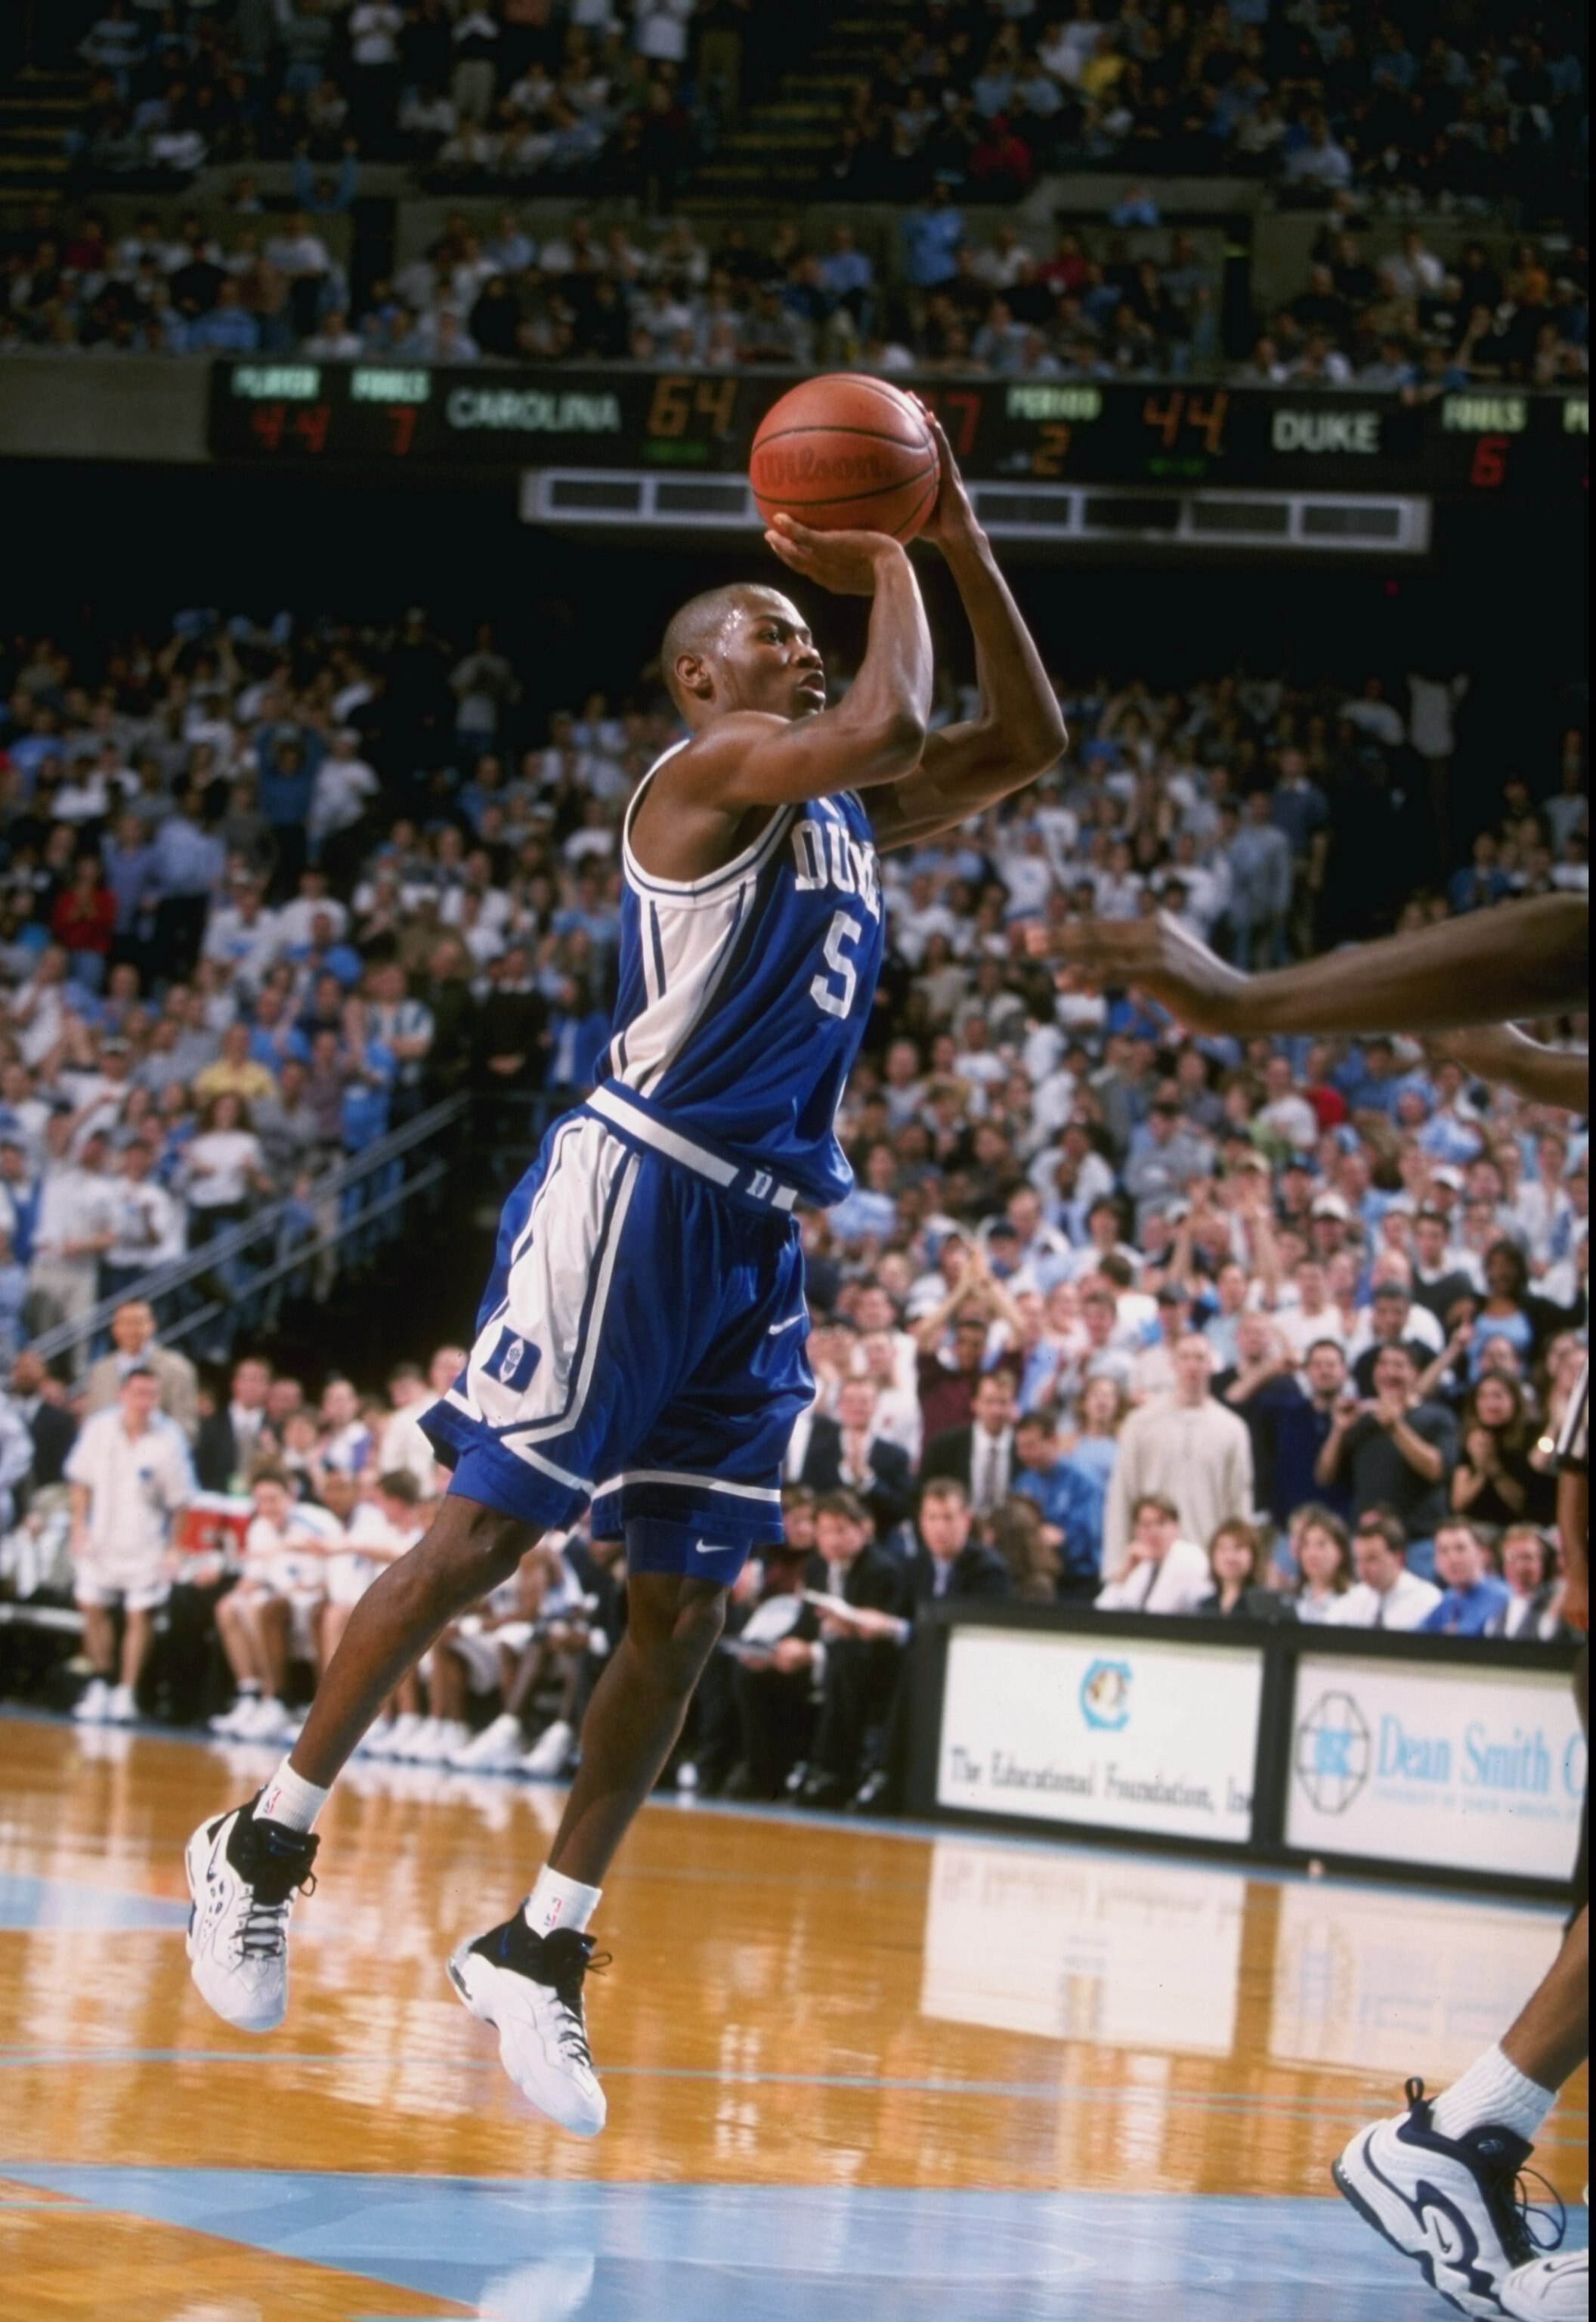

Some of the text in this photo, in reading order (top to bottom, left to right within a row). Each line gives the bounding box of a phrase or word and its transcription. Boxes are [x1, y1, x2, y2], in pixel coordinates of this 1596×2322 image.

[448, 391, 619, 431] CAROLINA
[648, 377, 738, 438] 64
[1273, 411, 1378, 453] DUKE
[810, 911, 861, 1020] 5
[950, 1745, 981, 1784] The
[989, 1749, 1095, 1797] Educational
[1377, 1713, 1450, 1782] Dean
[1461, 1720, 1551, 1794] Smith
